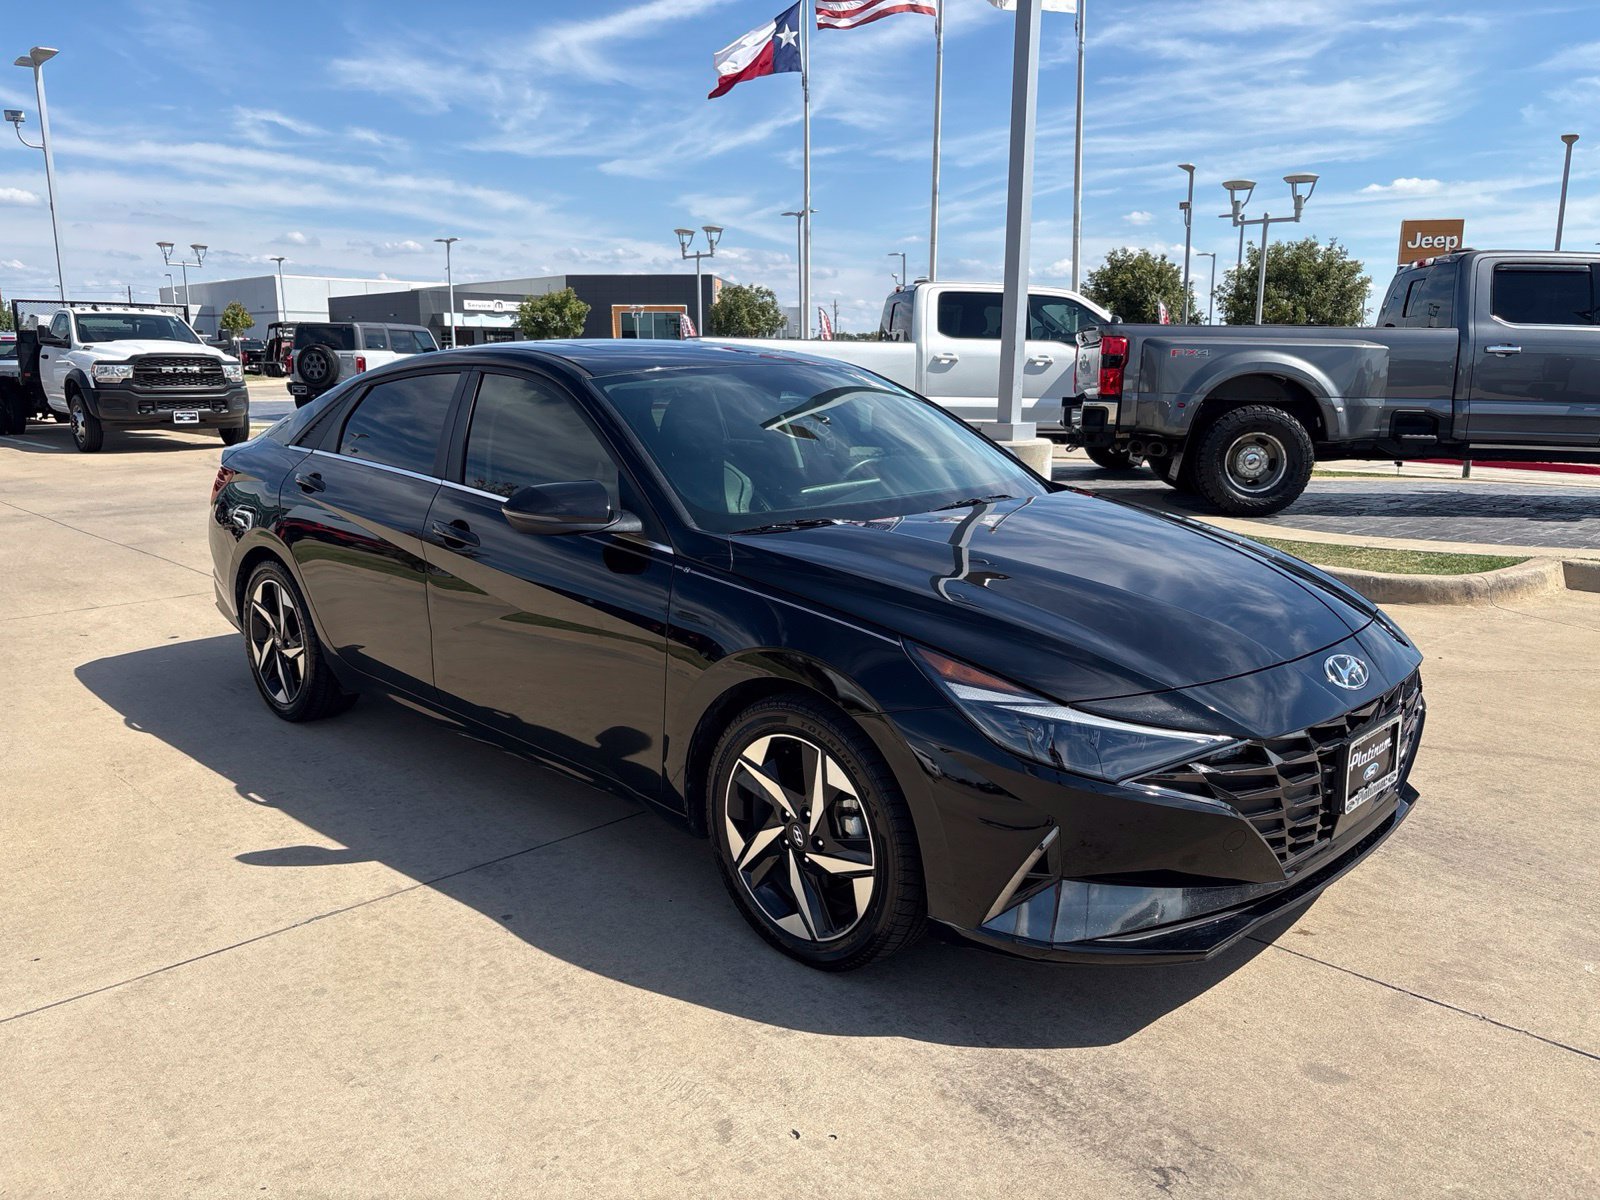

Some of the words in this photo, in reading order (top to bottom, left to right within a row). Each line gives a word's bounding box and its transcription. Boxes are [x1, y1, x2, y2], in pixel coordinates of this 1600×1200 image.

[1407, 232, 1459, 252] Jeep
[1170, 349, 1210, 357] FX4
[799, 720, 858, 775] TOURING
[1349, 737, 1392, 771] Platinum
